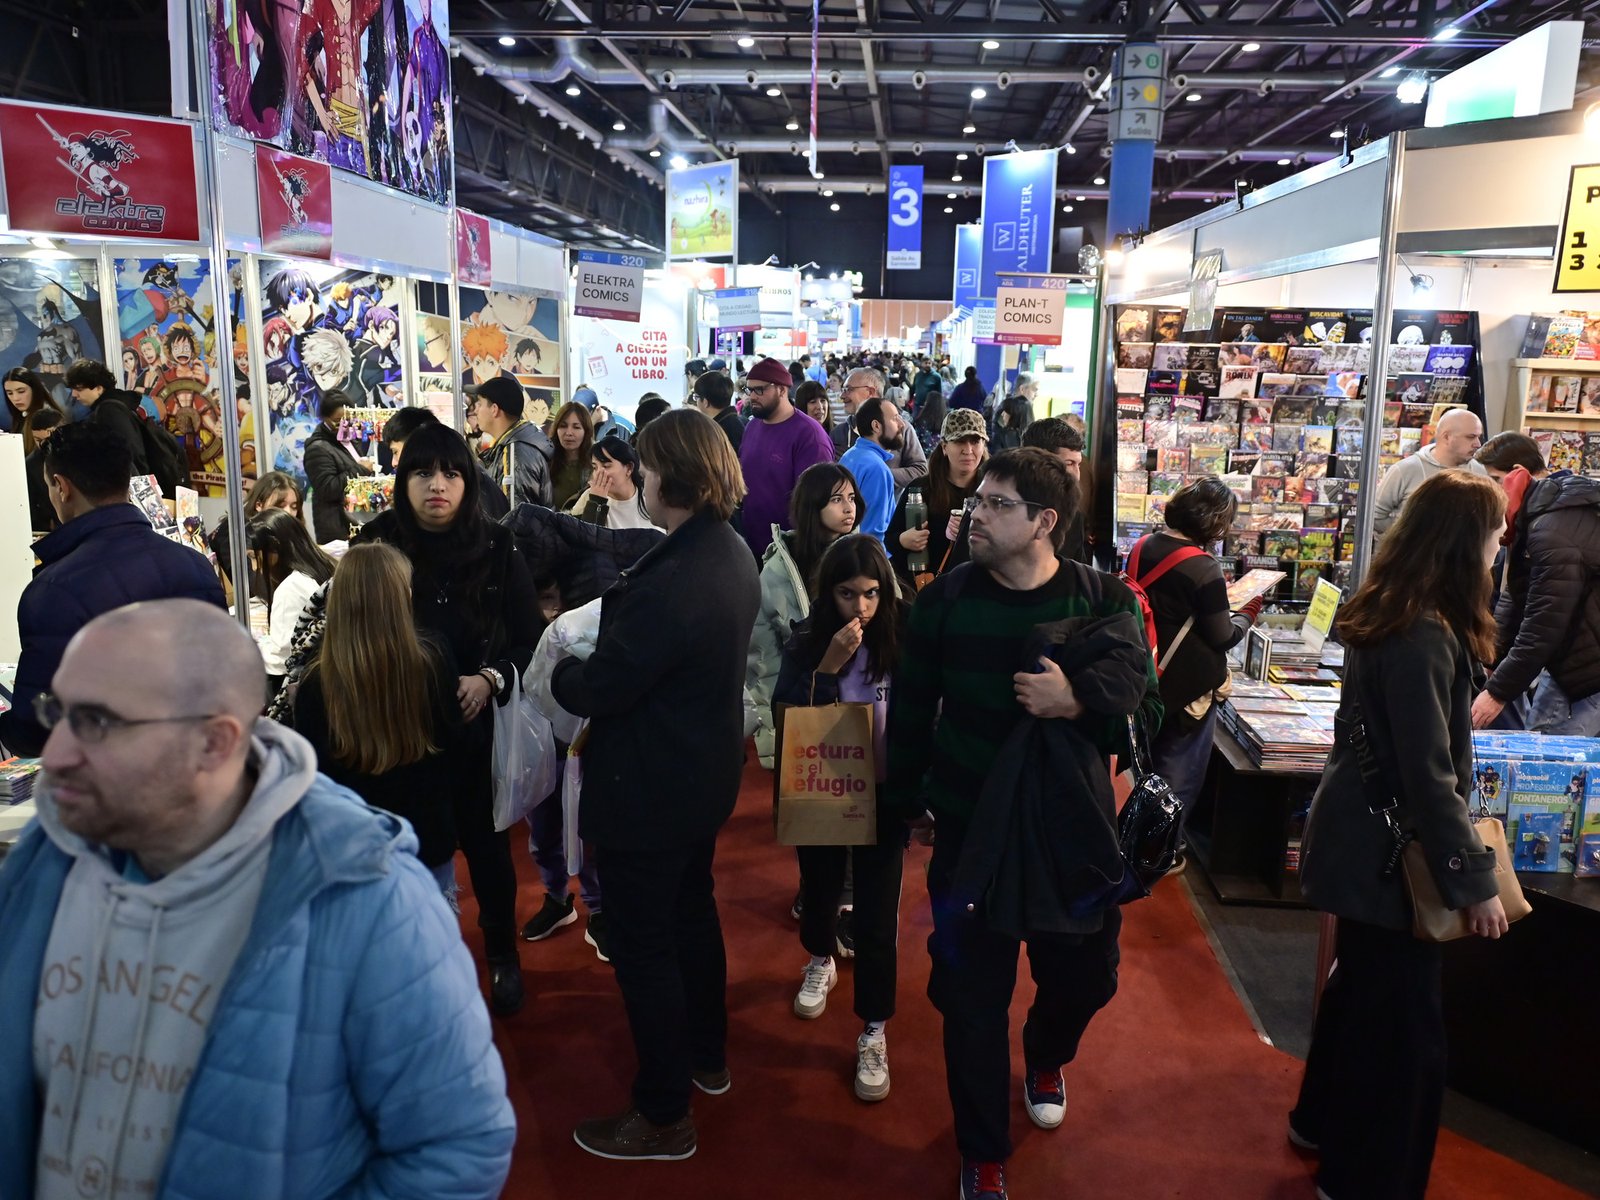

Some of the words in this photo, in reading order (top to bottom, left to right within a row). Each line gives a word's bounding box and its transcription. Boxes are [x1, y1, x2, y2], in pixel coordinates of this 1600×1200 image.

[1127, 127, 1153, 136] Salida
[56, 193, 165, 220] elektra
[891, 187, 920, 227] 3
[83, 215, 163, 232] comics
[1017, 183, 1033, 272] ALDHUTER
[1571, 231, 1587, 248] 1
[620, 255, 643, 267] 320
[1569, 254, 1585, 270] 3
[583, 273, 635, 288] ELEKTRA
[1041, 278, 1065, 289] 420
[582, 288, 630, 302] COMICS
[1004, 297, 1049, 308] PLAN-T
[1003, 312, 1052, 324] COMICS
[642, 331, 667, 341] CITA
[615, 343, 623, 353] A
[627, 343, 667, 354] CIEGAS
[624, 356, 647, 366] CON
[651, 357, 667, 366] UN
[632, 369, 667, 380] LIBRO.
[1225, 371, 1253, 379] RONIN
[1247, 556, 1278, 564] THANOS
[793, 742, 865, 760] ectura
[795, 764, 804, 774] s
[808, 760, 823, 775] el
[794, 773, 867, 797] efugio
[1516, 783, 1566, 792] PROFESIONES
[1512, 793, 1569, 804] FONTANEROS
[42, 955, 83, 1000] OS
[98, 957, 212, 1026] ANGEL
